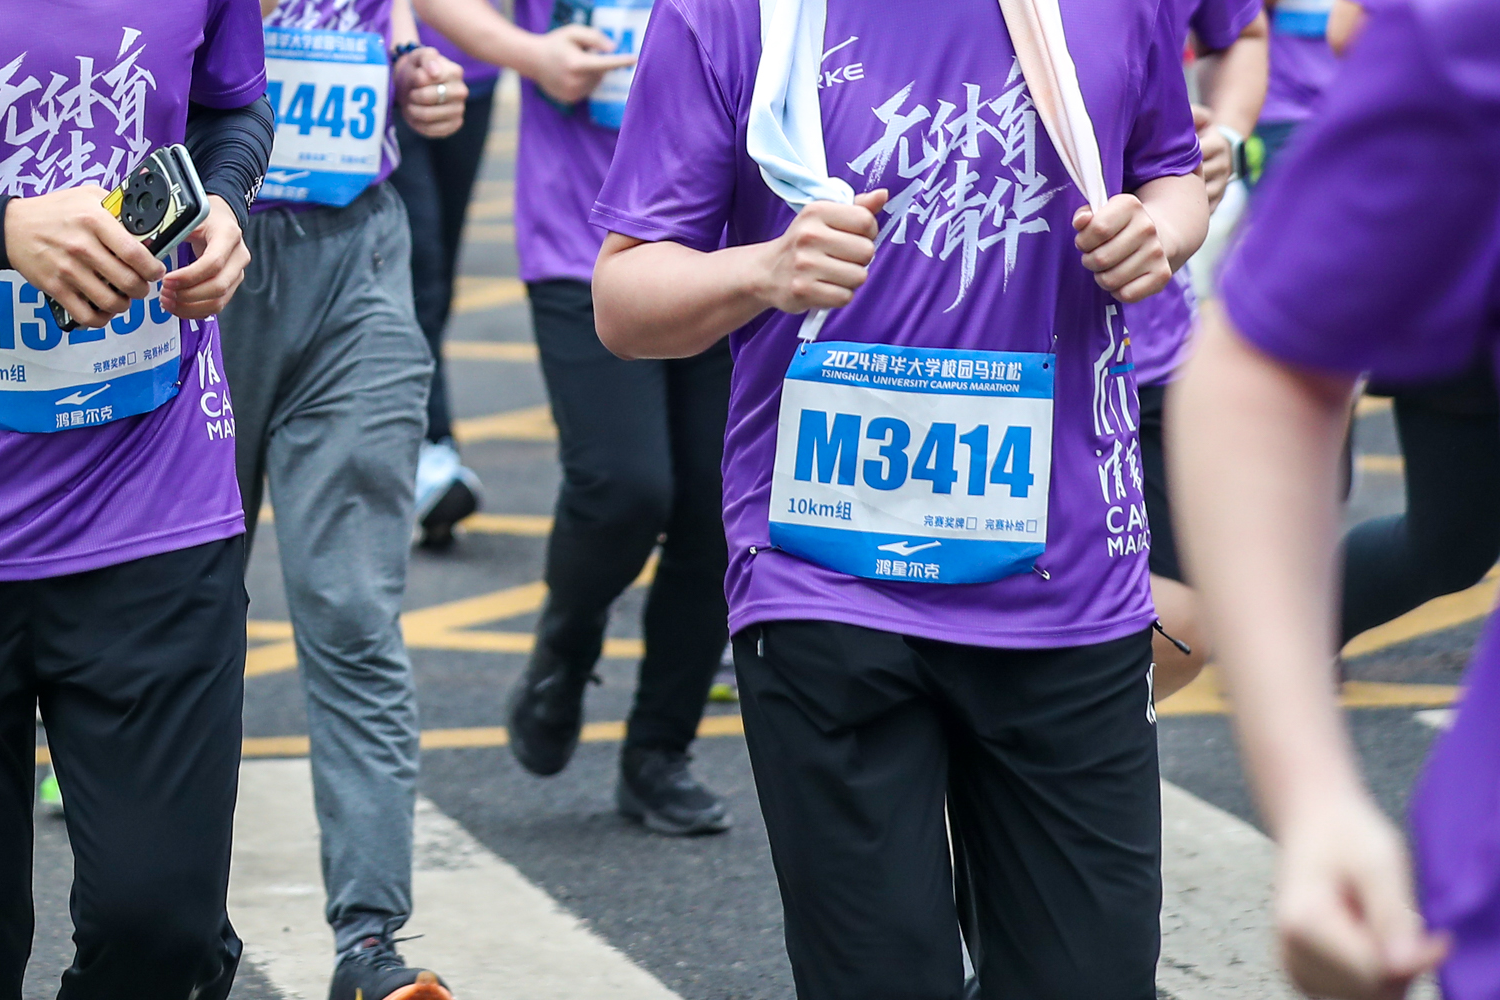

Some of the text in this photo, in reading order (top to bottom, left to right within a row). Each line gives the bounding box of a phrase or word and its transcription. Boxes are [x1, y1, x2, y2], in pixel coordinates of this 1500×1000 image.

[846, 55, 1049, 192] 无体育
[93, 354, 127, 374] 完赛奖牌
[821, 350, 1023, 382] 2024清华大学校园马拉松
[821, 368, 1020, 393] TSINGHUA UNIVERSITY CAMPUS MARATHON
[55, 405, 113, 429] 鸿星尔克
[793, 408, 1035, 499] M3414
[787, 497, 852, 521] 10km组
[923, 515, 1025, 532] 完赛奖牌 完赛补给
[875, 558, 940, 580] 鸿星尔克
